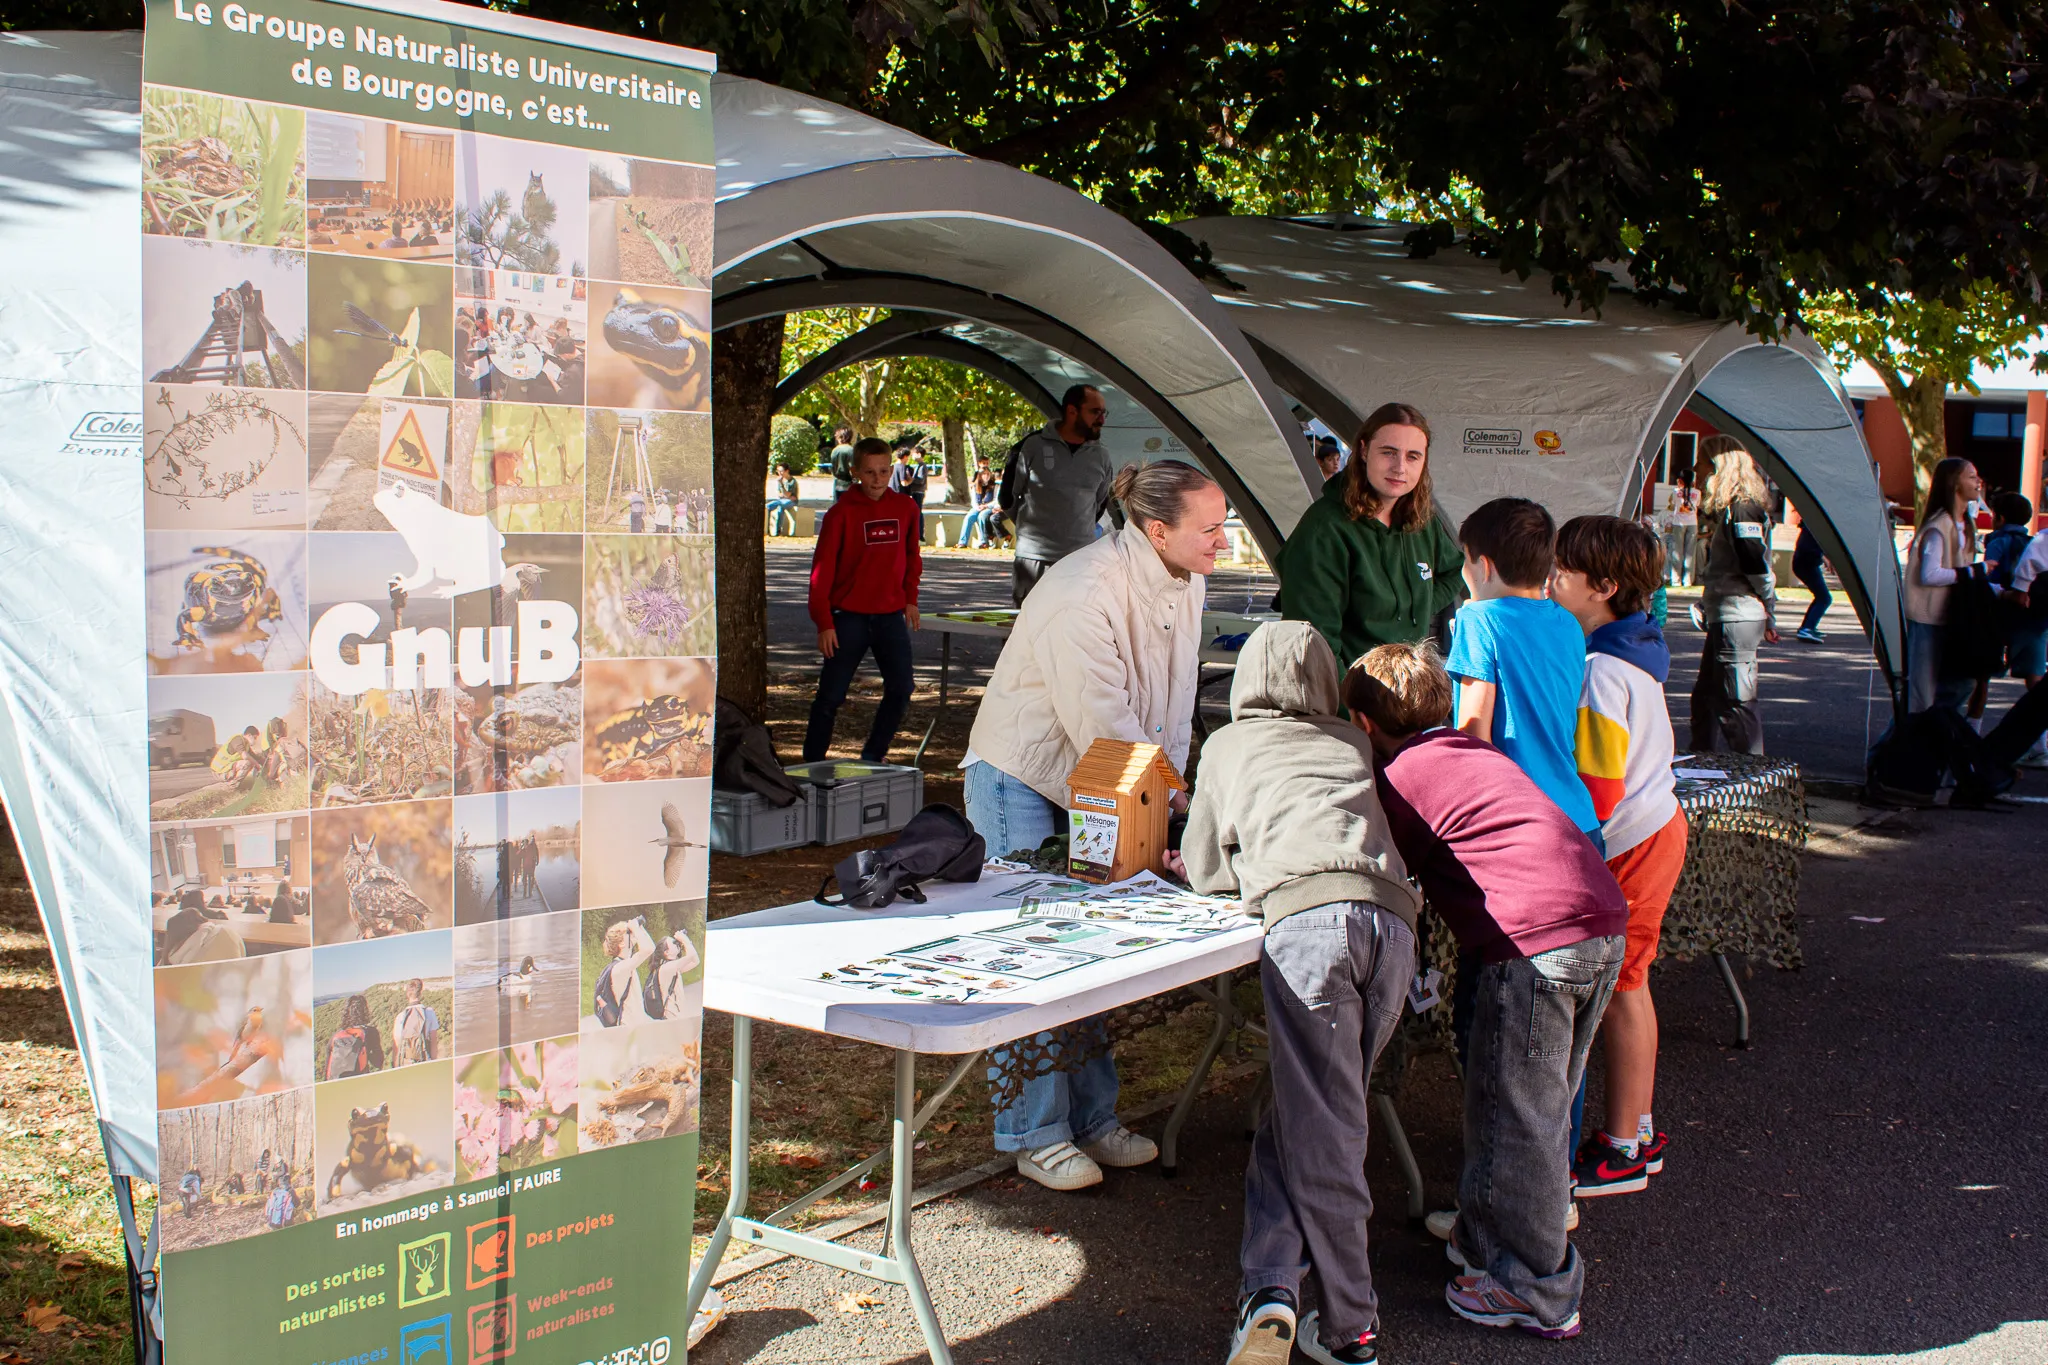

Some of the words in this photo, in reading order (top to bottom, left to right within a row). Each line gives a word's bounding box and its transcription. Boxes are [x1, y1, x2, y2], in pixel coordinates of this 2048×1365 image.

[174, 0, 212, 25] Le
[222, 3, 346, 51] Groupe
[355, 25, 520, 79] Naturaliste
[529, 56, 702, 109] Universitaire
[291, 58, 333, 88] de
[342, 64, 513, 121] Bourgogne,
[59, 443, 130, 457] Event
[1463, 446, 1494, 455] Event
[1495, 447, 1531, 456] Shelter
[1468, 431, 1509, 442] Coleman
[309, 601, 580, 696] GnuB
[1086, 814, 1116, 827] Mésanges
[336, 1222, 358, 1239] En
[362, 1200, 439, 1232] hommage
[443, 1195, 454, 1212] à
[458, 1180, 511, 1209] Samuel
[514, 1168, 562, 1193] FAURE
[526, 1229, 553, 1249] Des
[557, 1213, 615, 1243] projets
[286, 1279, 318, 1301] Des
[323, 1261, 386, 1290] sorties
[526, 1276, 614, 1313] Week-ends
[279, 1291, 387, 1334] naturalistes
[526, 1302, 615, 1341] naturalistes
